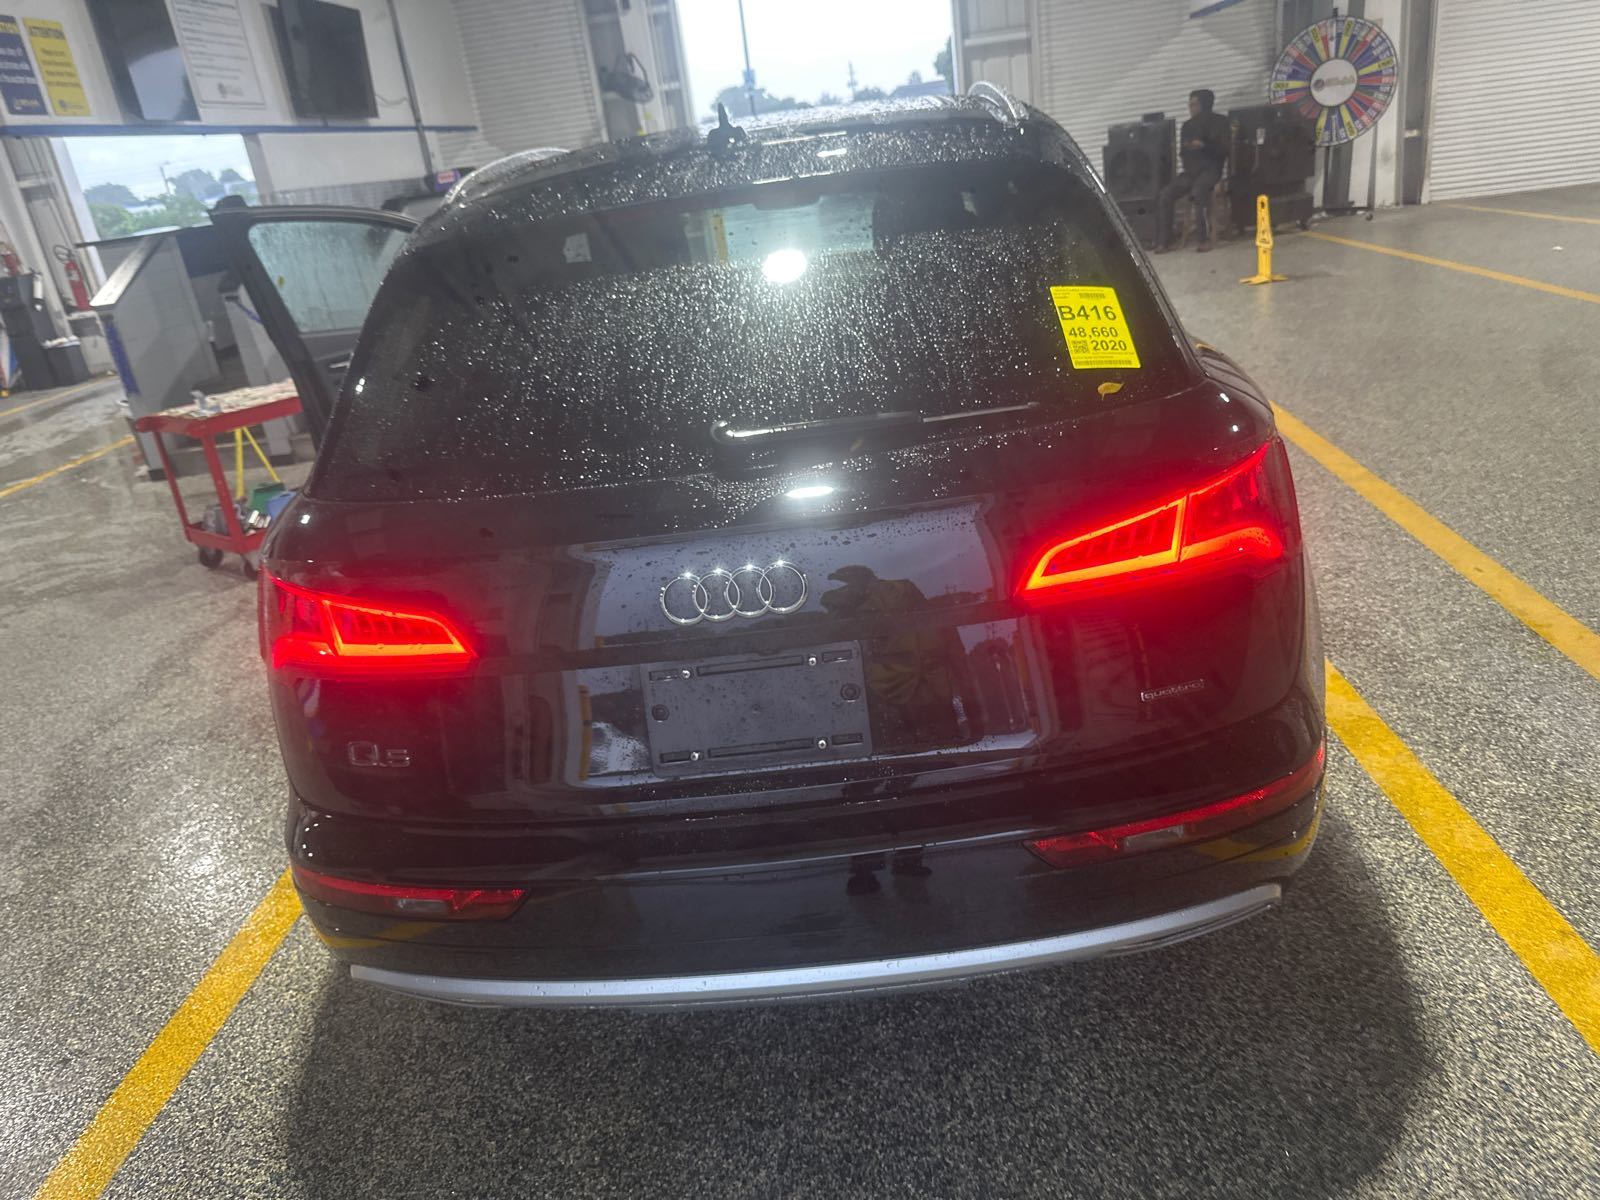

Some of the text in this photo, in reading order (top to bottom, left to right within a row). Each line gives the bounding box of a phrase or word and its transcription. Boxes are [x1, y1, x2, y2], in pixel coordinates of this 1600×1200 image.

[1058, 305, 1117, 321] B416
[1068, 326, 1119, 339] 48,660
[1090, 340, 1127, 351] 2020
[1142, 679, 1205, 701] quattro
[347, 740, 411, 768] Q5
